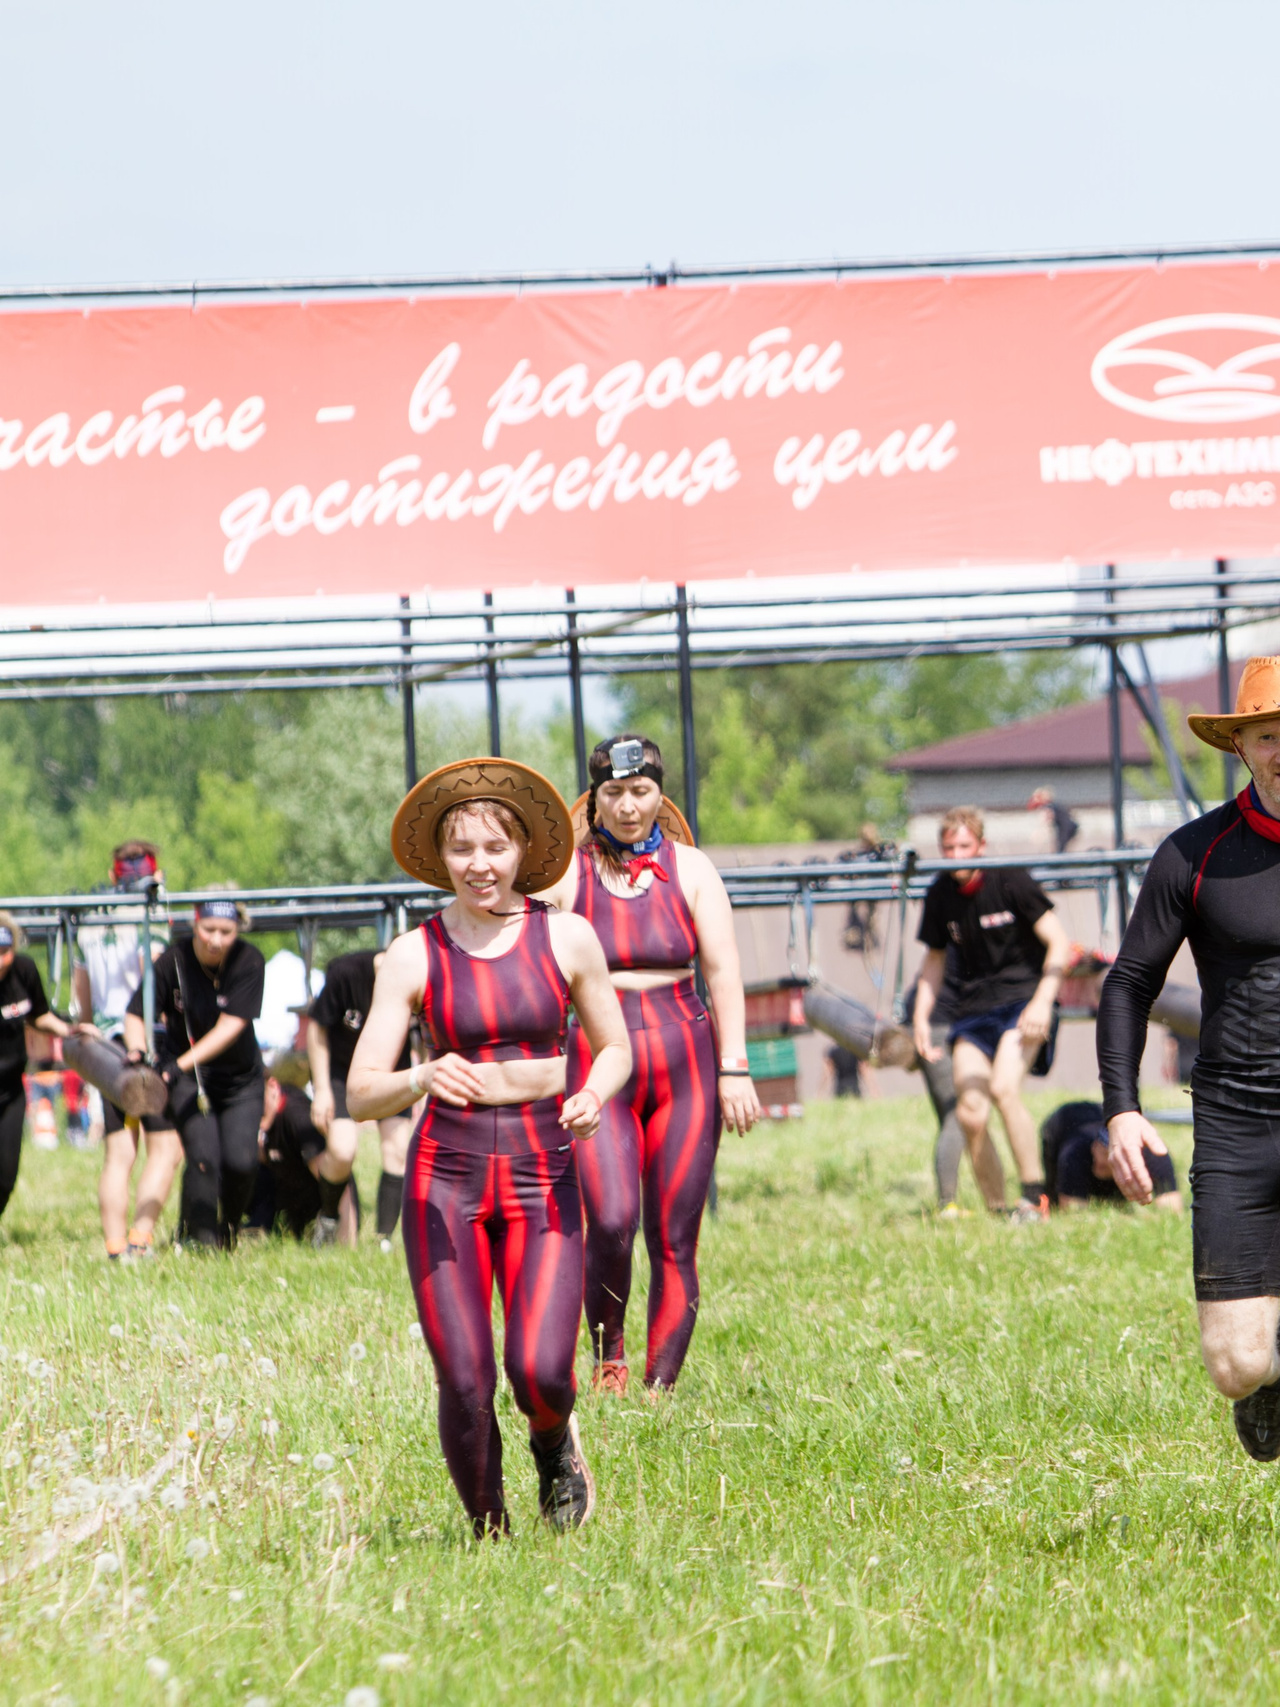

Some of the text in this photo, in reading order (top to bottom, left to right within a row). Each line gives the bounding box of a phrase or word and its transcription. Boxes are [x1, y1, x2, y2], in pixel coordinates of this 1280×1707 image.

[408, 341, 457, 434] в
[482, 326, 845, 452] радости
[218, 420, 959, 575] достижения цели
[1224, 481, 1277, 508] АЗС
